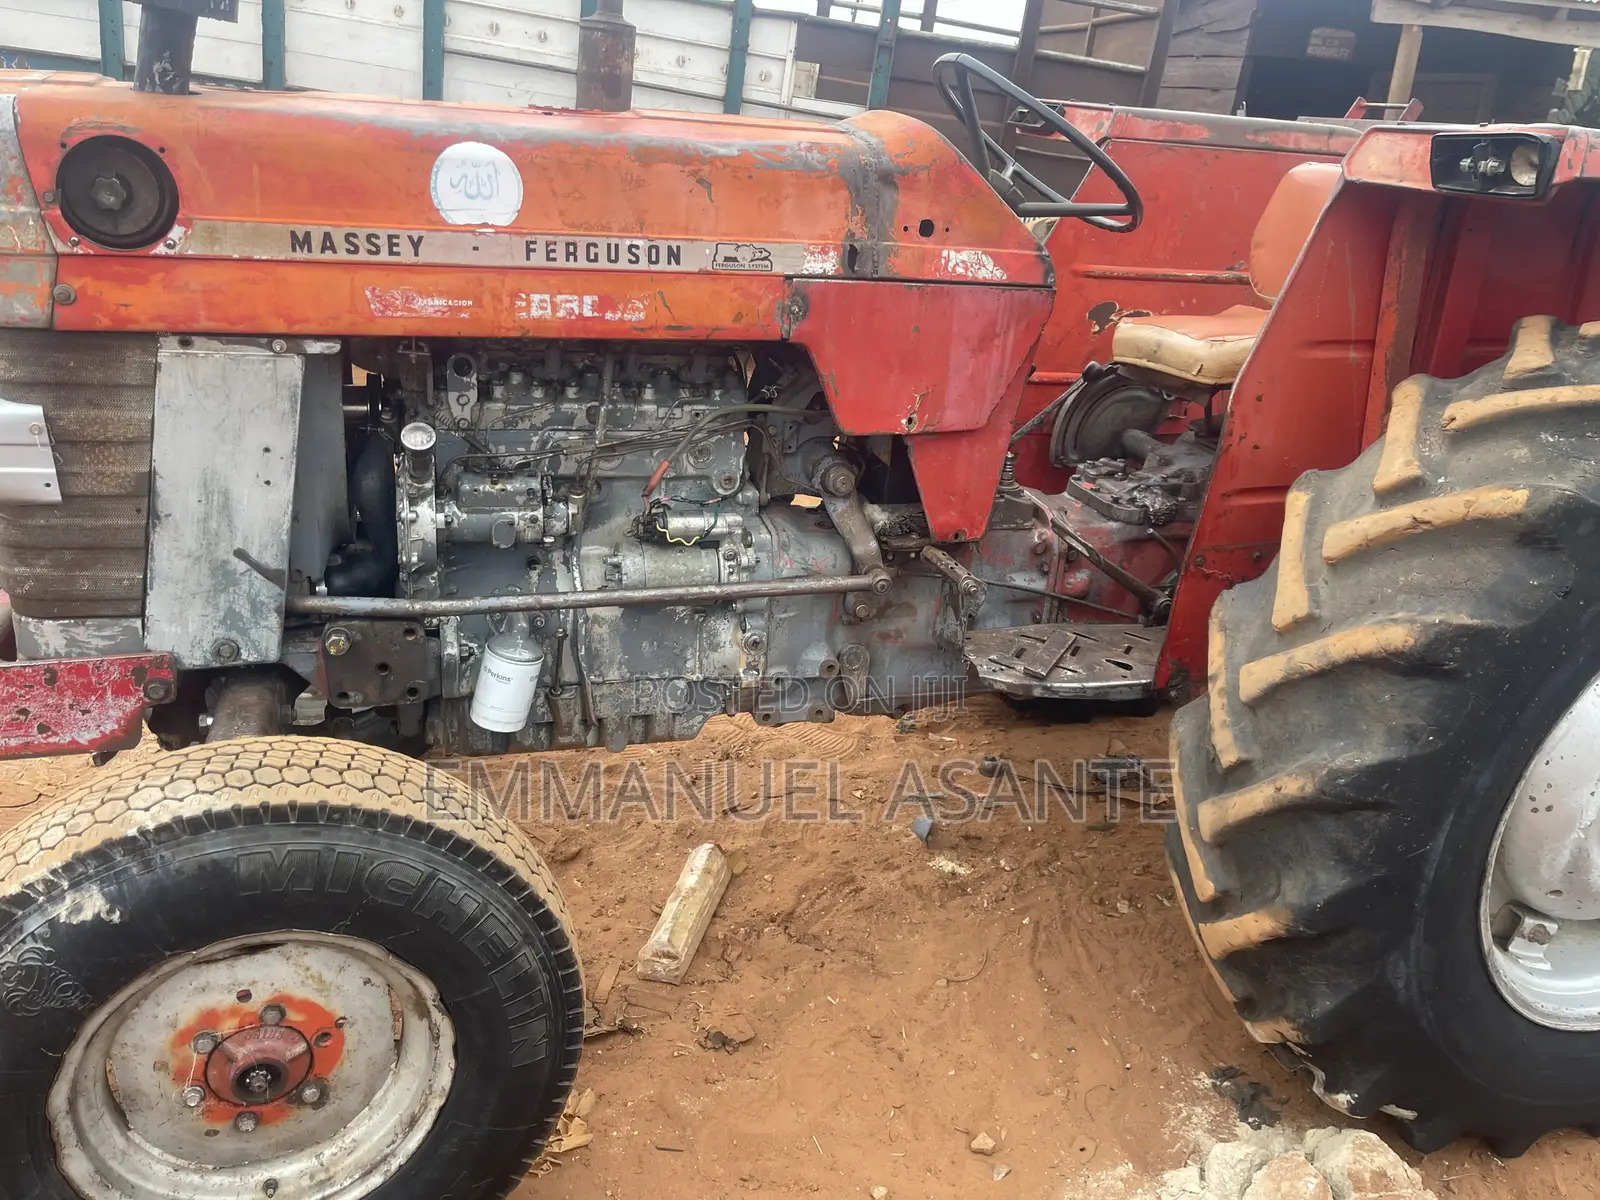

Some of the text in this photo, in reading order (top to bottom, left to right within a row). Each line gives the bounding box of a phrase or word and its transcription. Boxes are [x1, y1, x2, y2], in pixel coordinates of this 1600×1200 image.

[290, 230, 424, 257] MASSEY
[525, 240, 681, 266] FERGUSON
[487, 668, 512, 682] Perkins
[236, 848, 550, 1068] MICHELIN
